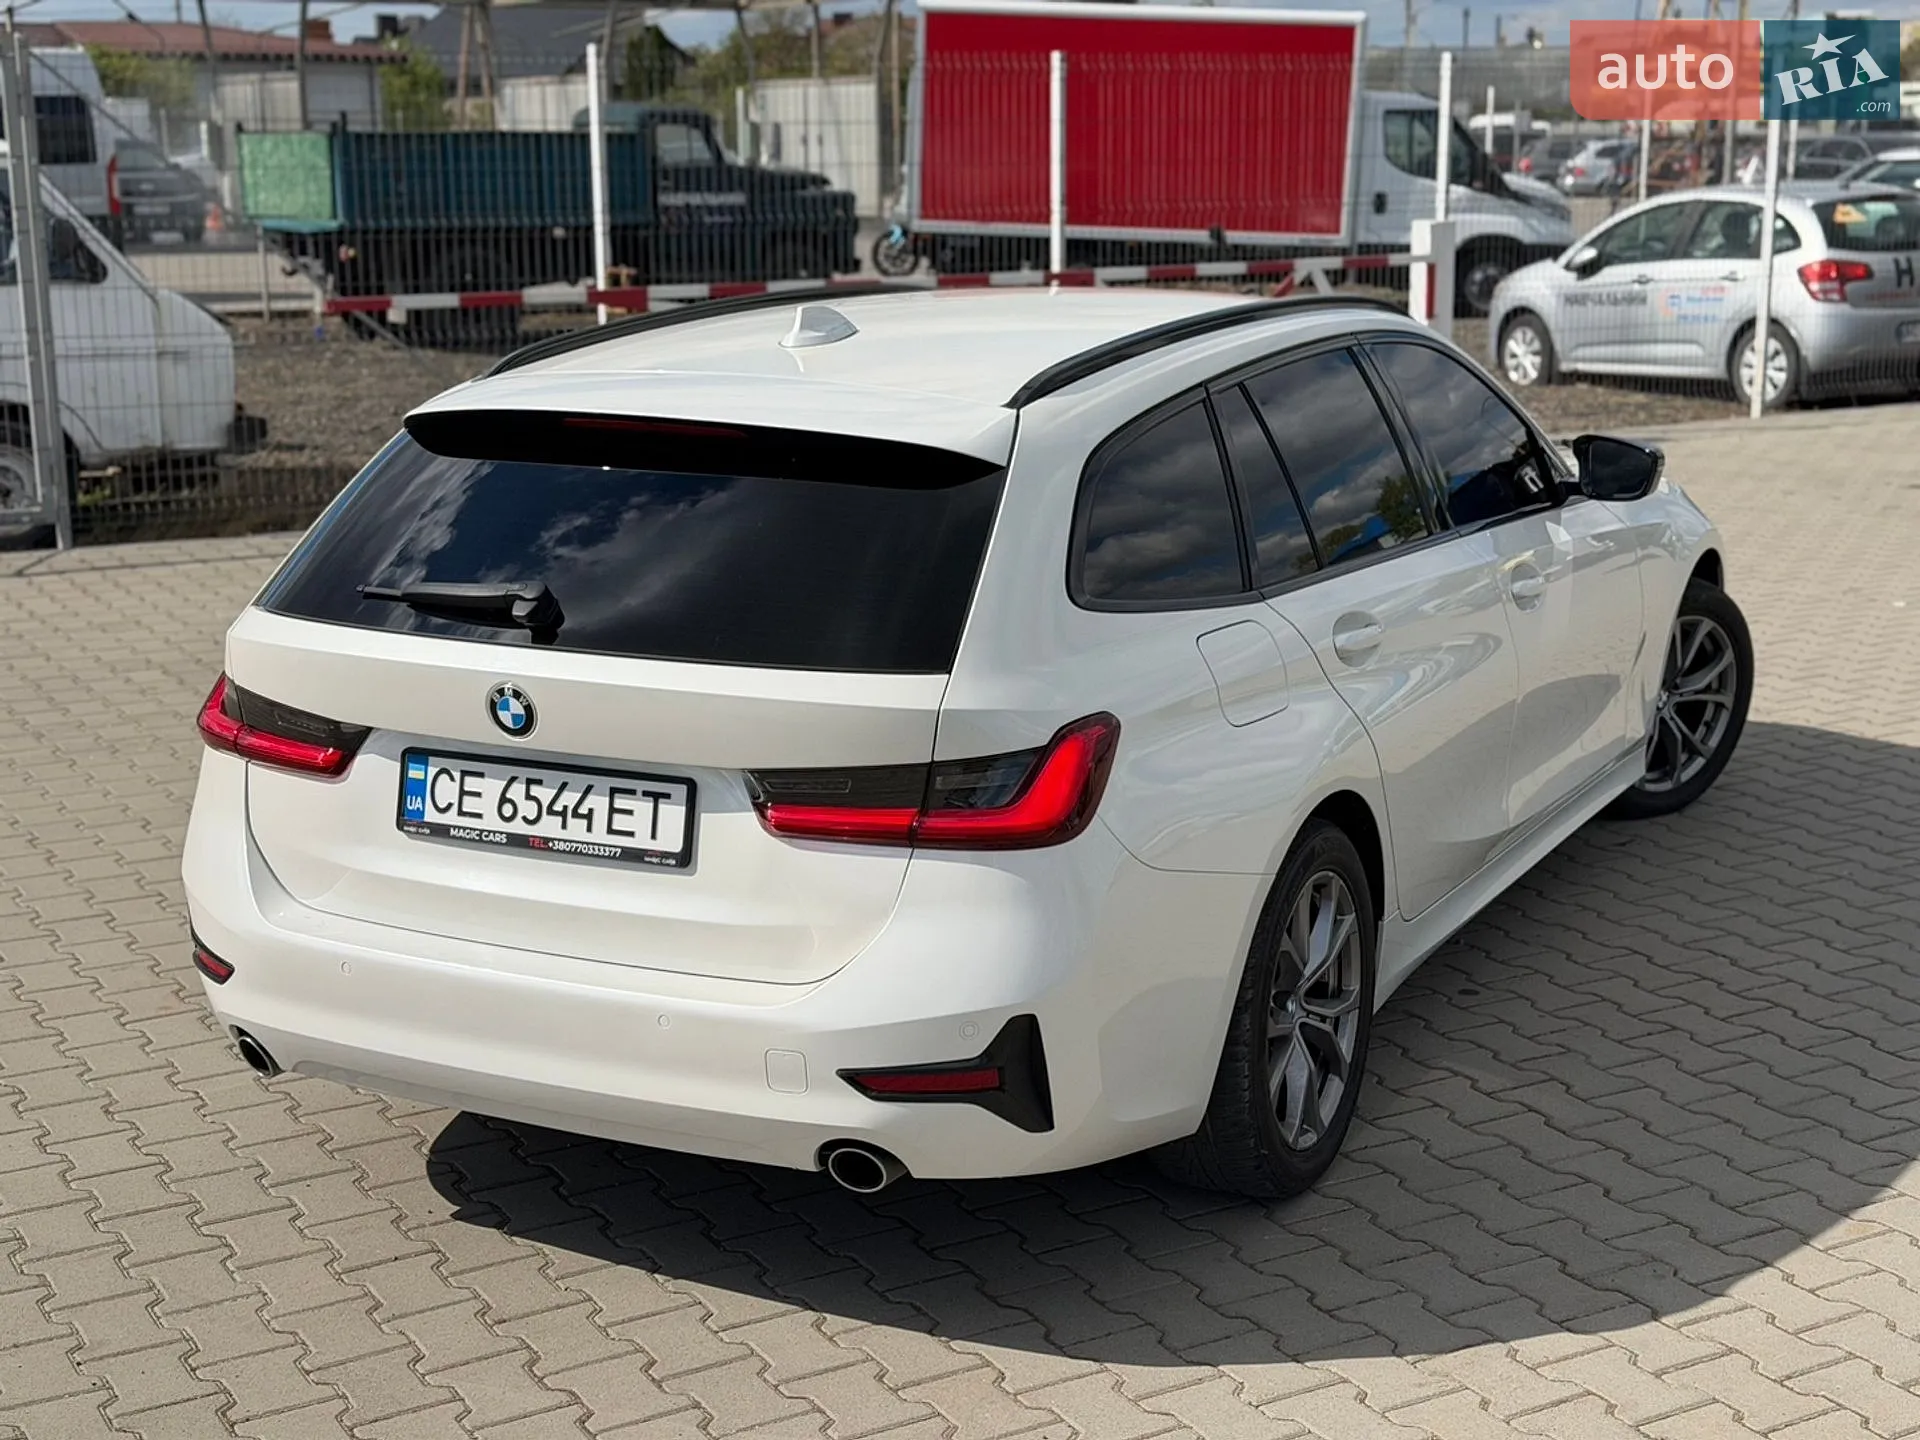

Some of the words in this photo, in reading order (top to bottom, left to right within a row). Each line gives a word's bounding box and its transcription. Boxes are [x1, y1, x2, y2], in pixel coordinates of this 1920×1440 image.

[406, 795, 423, 812] UA
[430, 767, 485, 820] CE
[496, 775, 595, 834] 6544
[606, 786, 672, 841] ET
[449, 827, 481, 840] MAGIC
[481, 832, 508, 844] CARS
